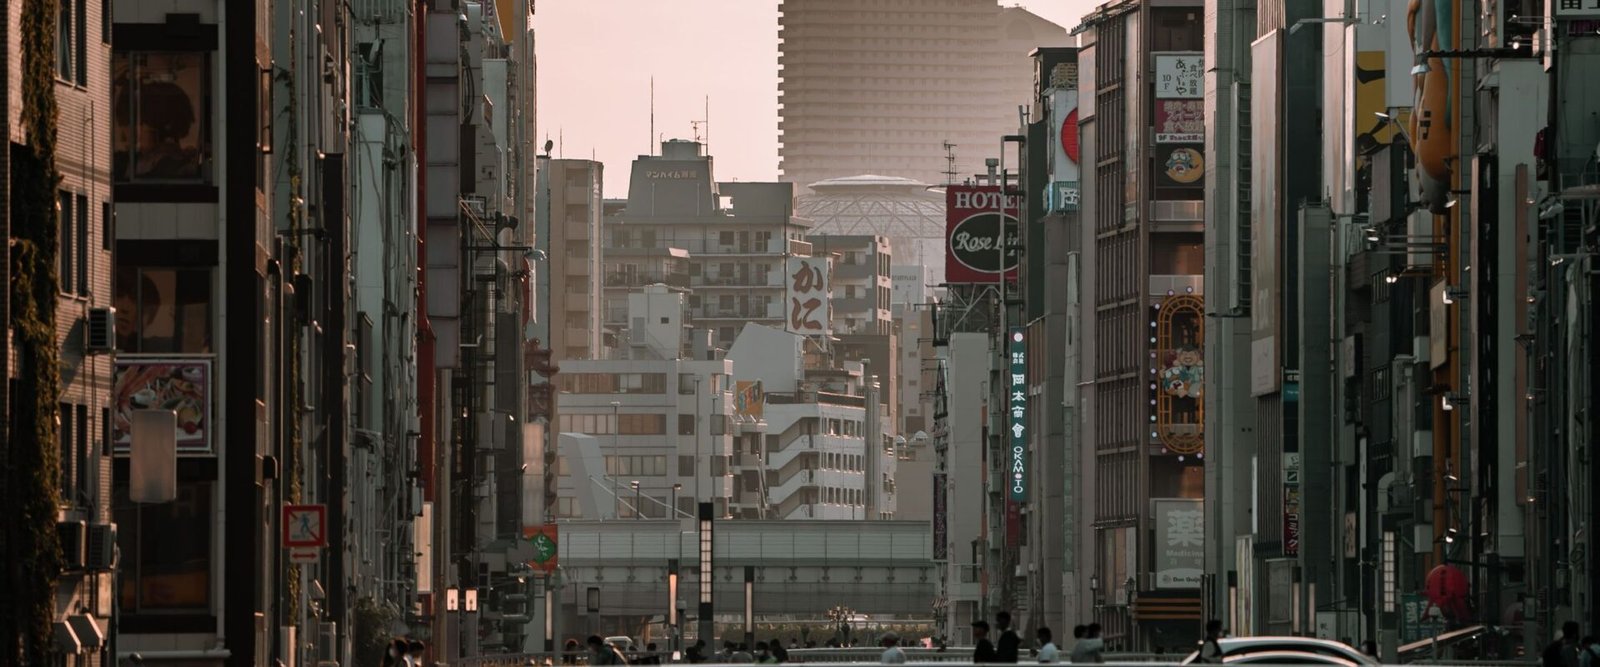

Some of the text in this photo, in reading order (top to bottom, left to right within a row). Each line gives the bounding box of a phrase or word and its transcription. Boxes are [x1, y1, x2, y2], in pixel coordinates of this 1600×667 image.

[1162, 74, 1172, 82] 10
[1164, 82, 1170, 90] F
[954, 191, 1018, 209] HOTE
[955, 231, 992, 253] Rose
[791, 260, 824, 330] かに
[1167, 510, 1204, 548] 薬
